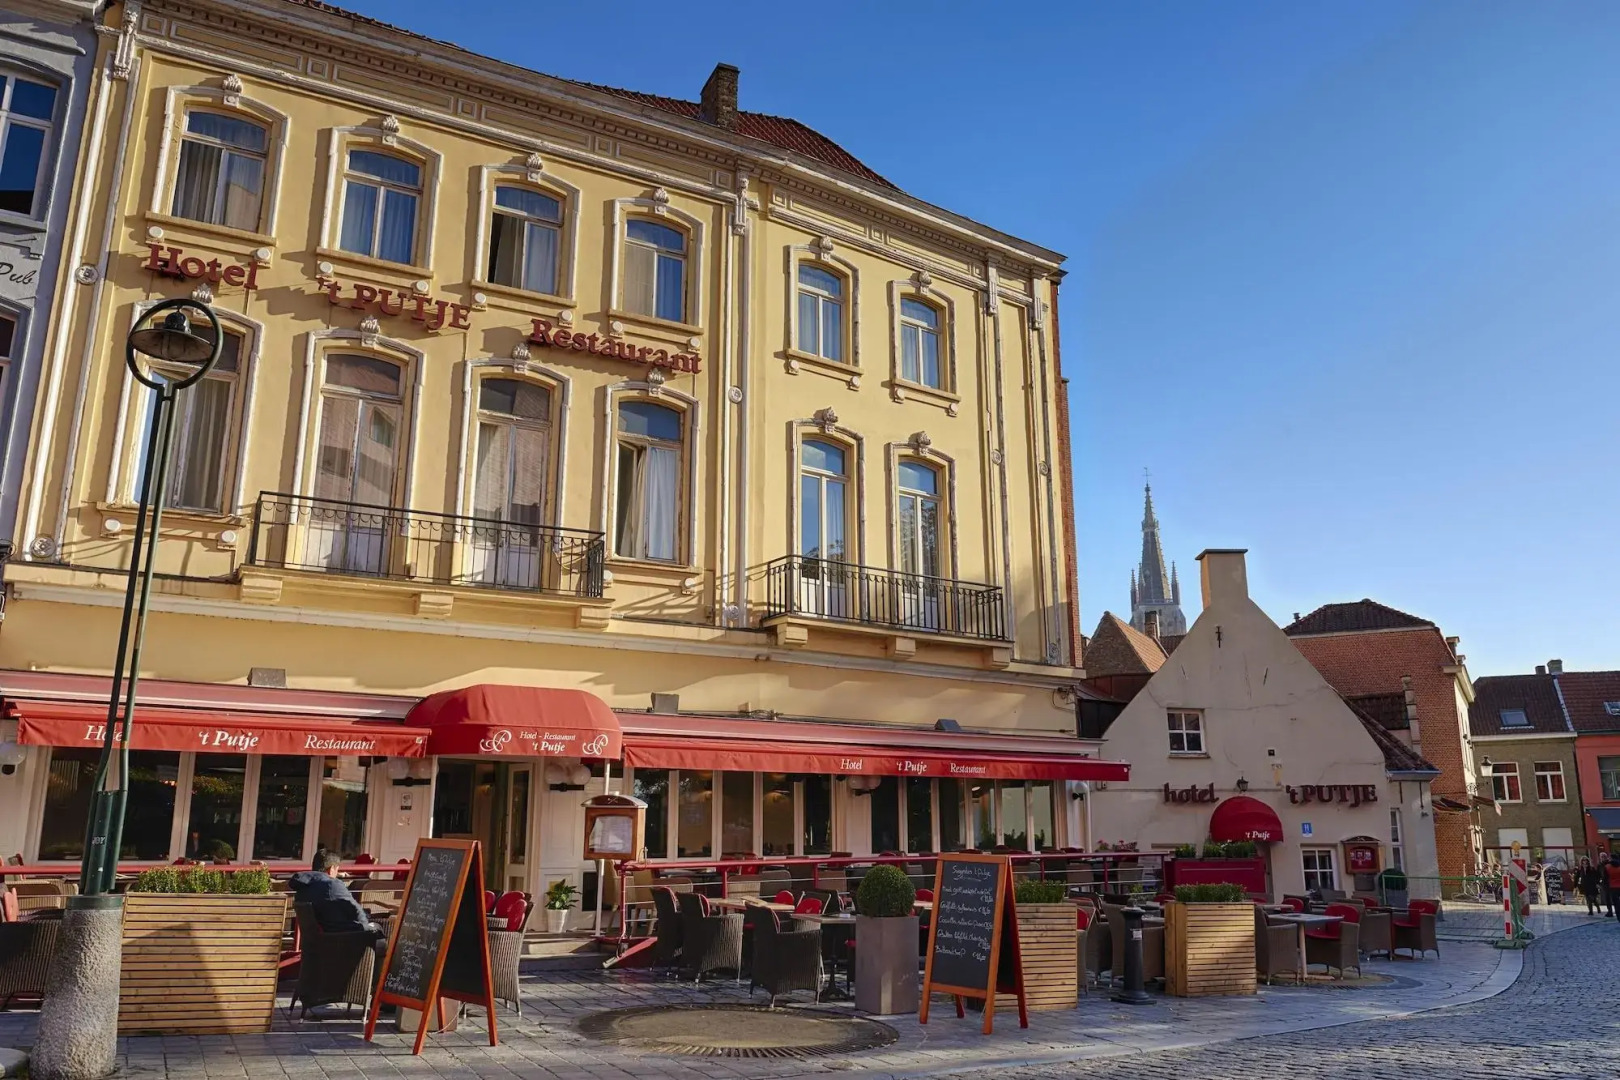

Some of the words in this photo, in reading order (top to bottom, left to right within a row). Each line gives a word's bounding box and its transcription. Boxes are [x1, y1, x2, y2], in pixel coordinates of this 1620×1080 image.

[145, 243, 259, 290] Hotel
[350, 282, 471, 330] PUTJE
[528, 317, 702, 375] Restaurant
[84, 724, 123, 742] Hte
[212, 730, 259, 750] Putje
[304, 734, 376, 750] Restaurant
[520, 731, 538, 739] Hotel
[544, 732, 575, 740] Restaurant
[540, 741, 566, 753] Putje
[840, 758, 863, 770] Hotel
[904, 760, 927, 775] Putje
[950, 763, 986, 774] Restaurant
[1164, 783, 1219, 803] hotel
[1301, 785, 1378, 807] PUTJE
[1252, 830, 1270, 840] Putje
